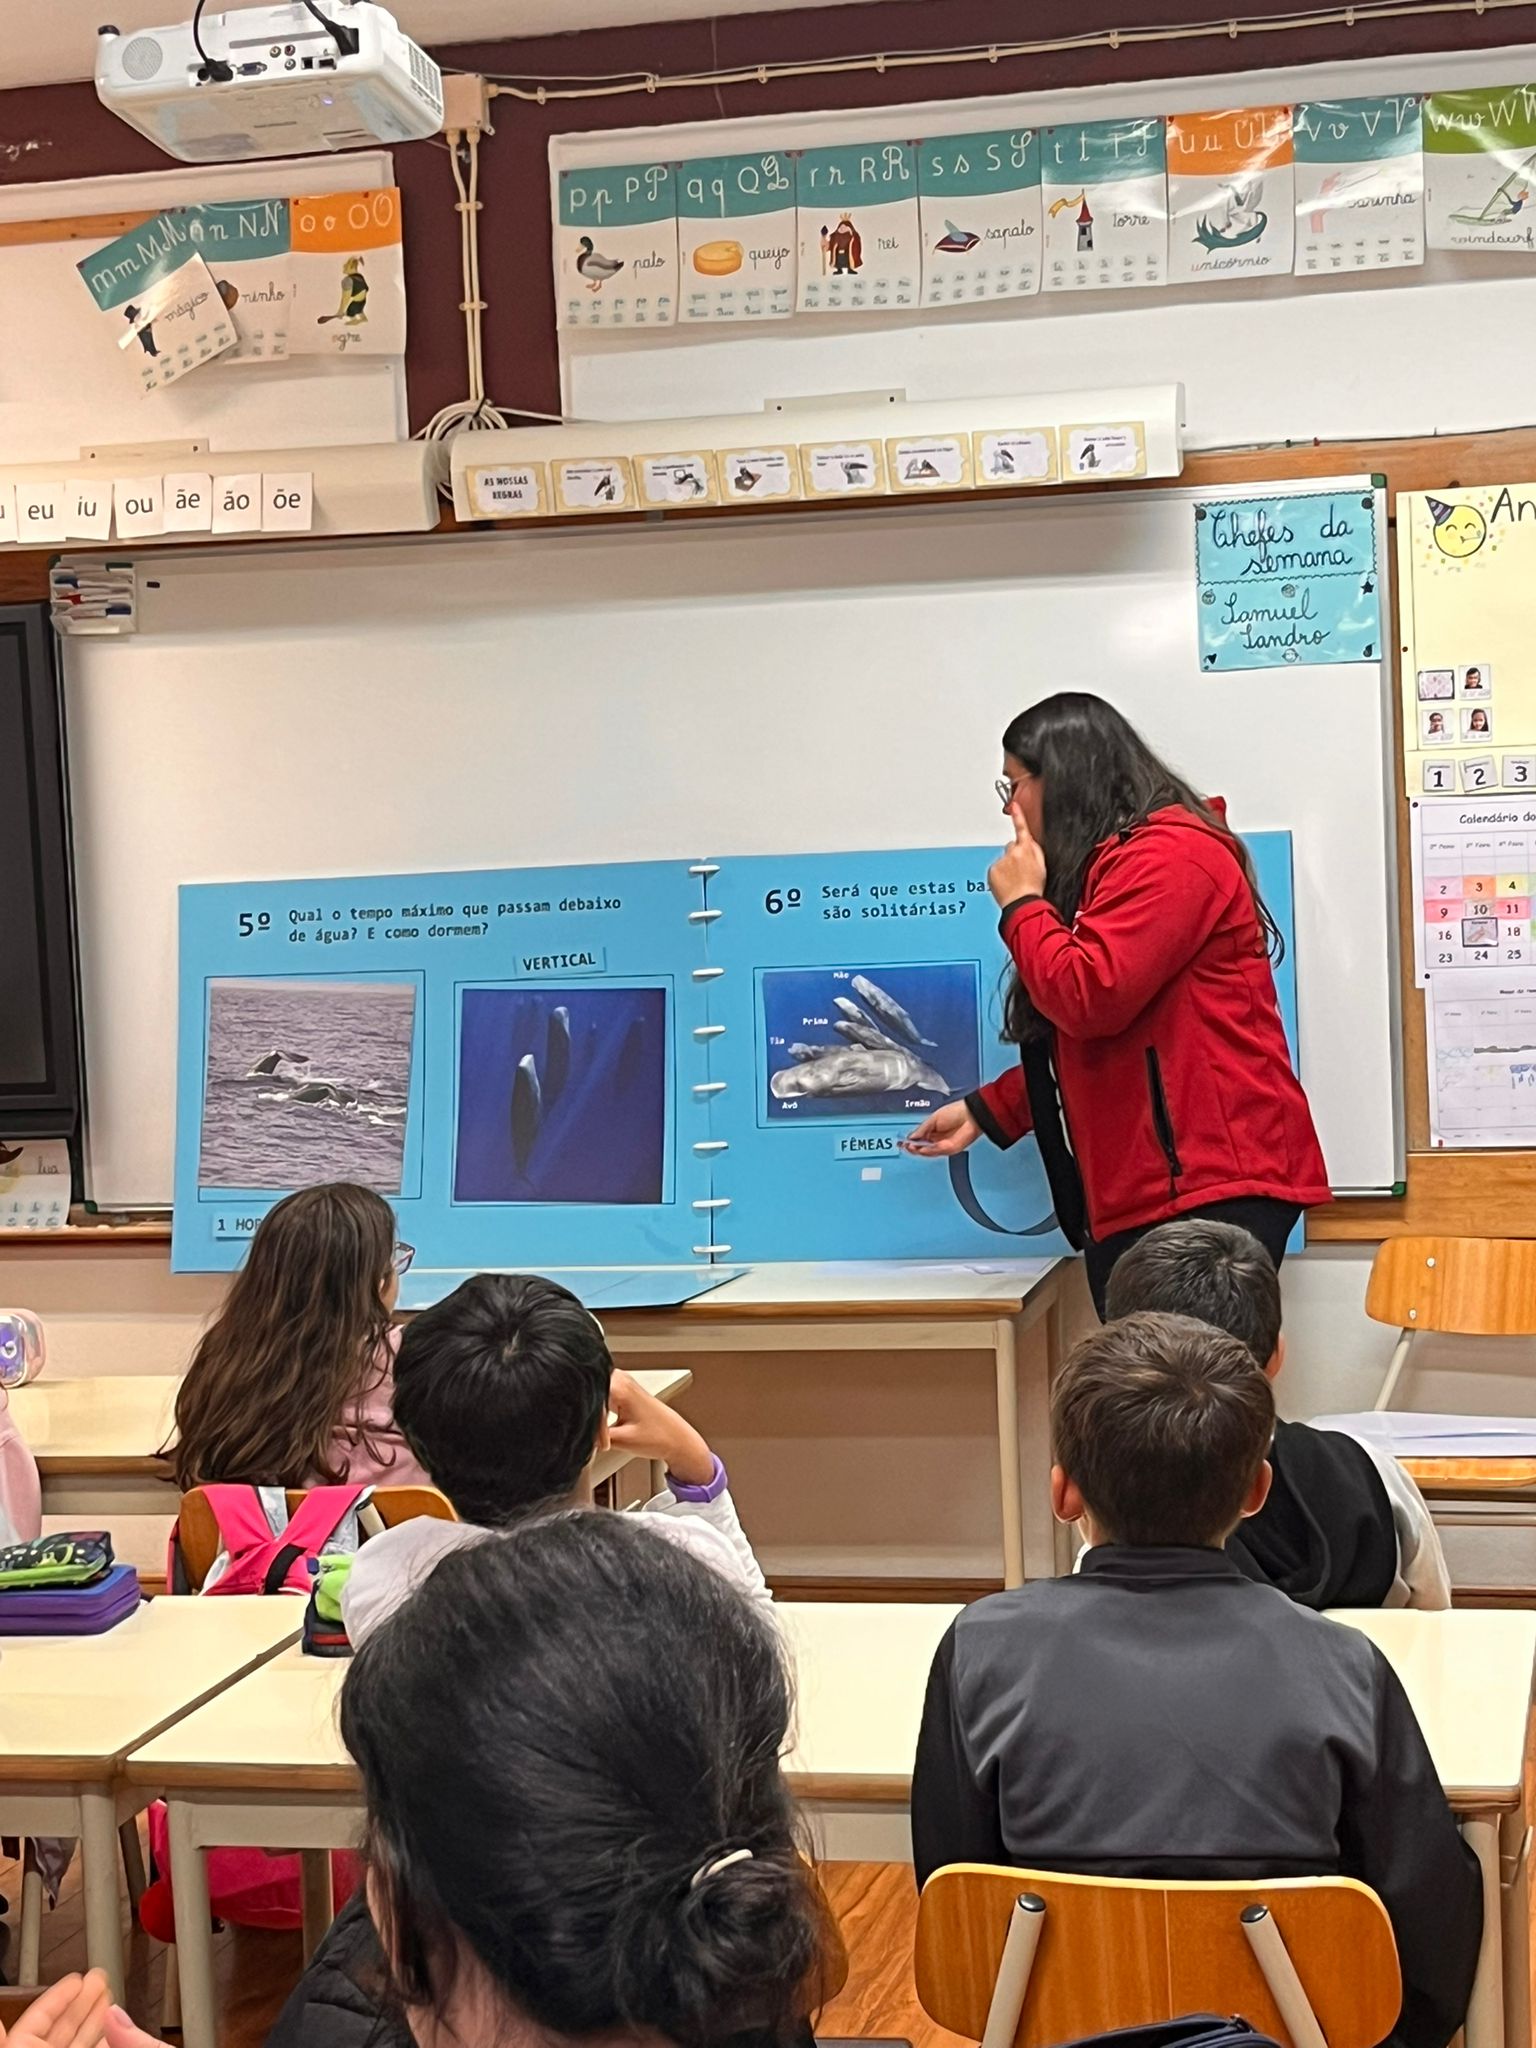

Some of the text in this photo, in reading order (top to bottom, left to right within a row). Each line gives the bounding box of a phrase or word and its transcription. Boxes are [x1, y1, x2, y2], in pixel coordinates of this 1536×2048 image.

[984, 218, 1036, 250] sapato
[632, 251, 666, 280] pato
[241, 280, 286, 304] ninho
[77, 496, 97, 517] iu
[125, 496, 154, 515] ou
[175, 489, 201, 510] ãe
[223, 490, 251, 511] ão
[273, 488, 301, 510] õe
[28, 504, 54, 520] eu
[1211, 502, 1354, 563] Chefes da
[1240, 549, 1353, 576] semana
[1221, 587, 1319, 625] Samuel
[1434, 770, 1444, 788] 1
[1473, 767, 1487, 786] 2
[1514, 765, 1528, 783] 3
[1459, 811, 1519, 825] Calendário
[821, 879, 991, 899] Será que estas ba
[1440, 885, 1447, 895] 2
[1475, 882, 1483, 892] 3
[1508, 881, 1516, 890] 4
[288, 896, 622, 924] Qual o tempo máximo que passam debaixo
[764, 888, 801, 915] 6º
[823, 900, 967, 919] são solitárias?
[1474, 904, 1488, 915] 10
[1507, 904, 1518, 914] 11
[1440, 908, 1448, 918] 9
[239, 912, 271, 937] 5º
[288, 922, 489, 944] de água? E como dormem?
[1507, 927, 1521, 936] 18
[1438, 930, 1452, 941] 16
[522, 952, 597, 971] VERTICAL
[1439, 953, 1453, 963] 23
[1474, 951, 1488, 960] 24
[1507, 949, 1521, 960] 25
[840, 1136, 893, 1152] FÊMEAS
[217, 1218, 226, 1231] 1
